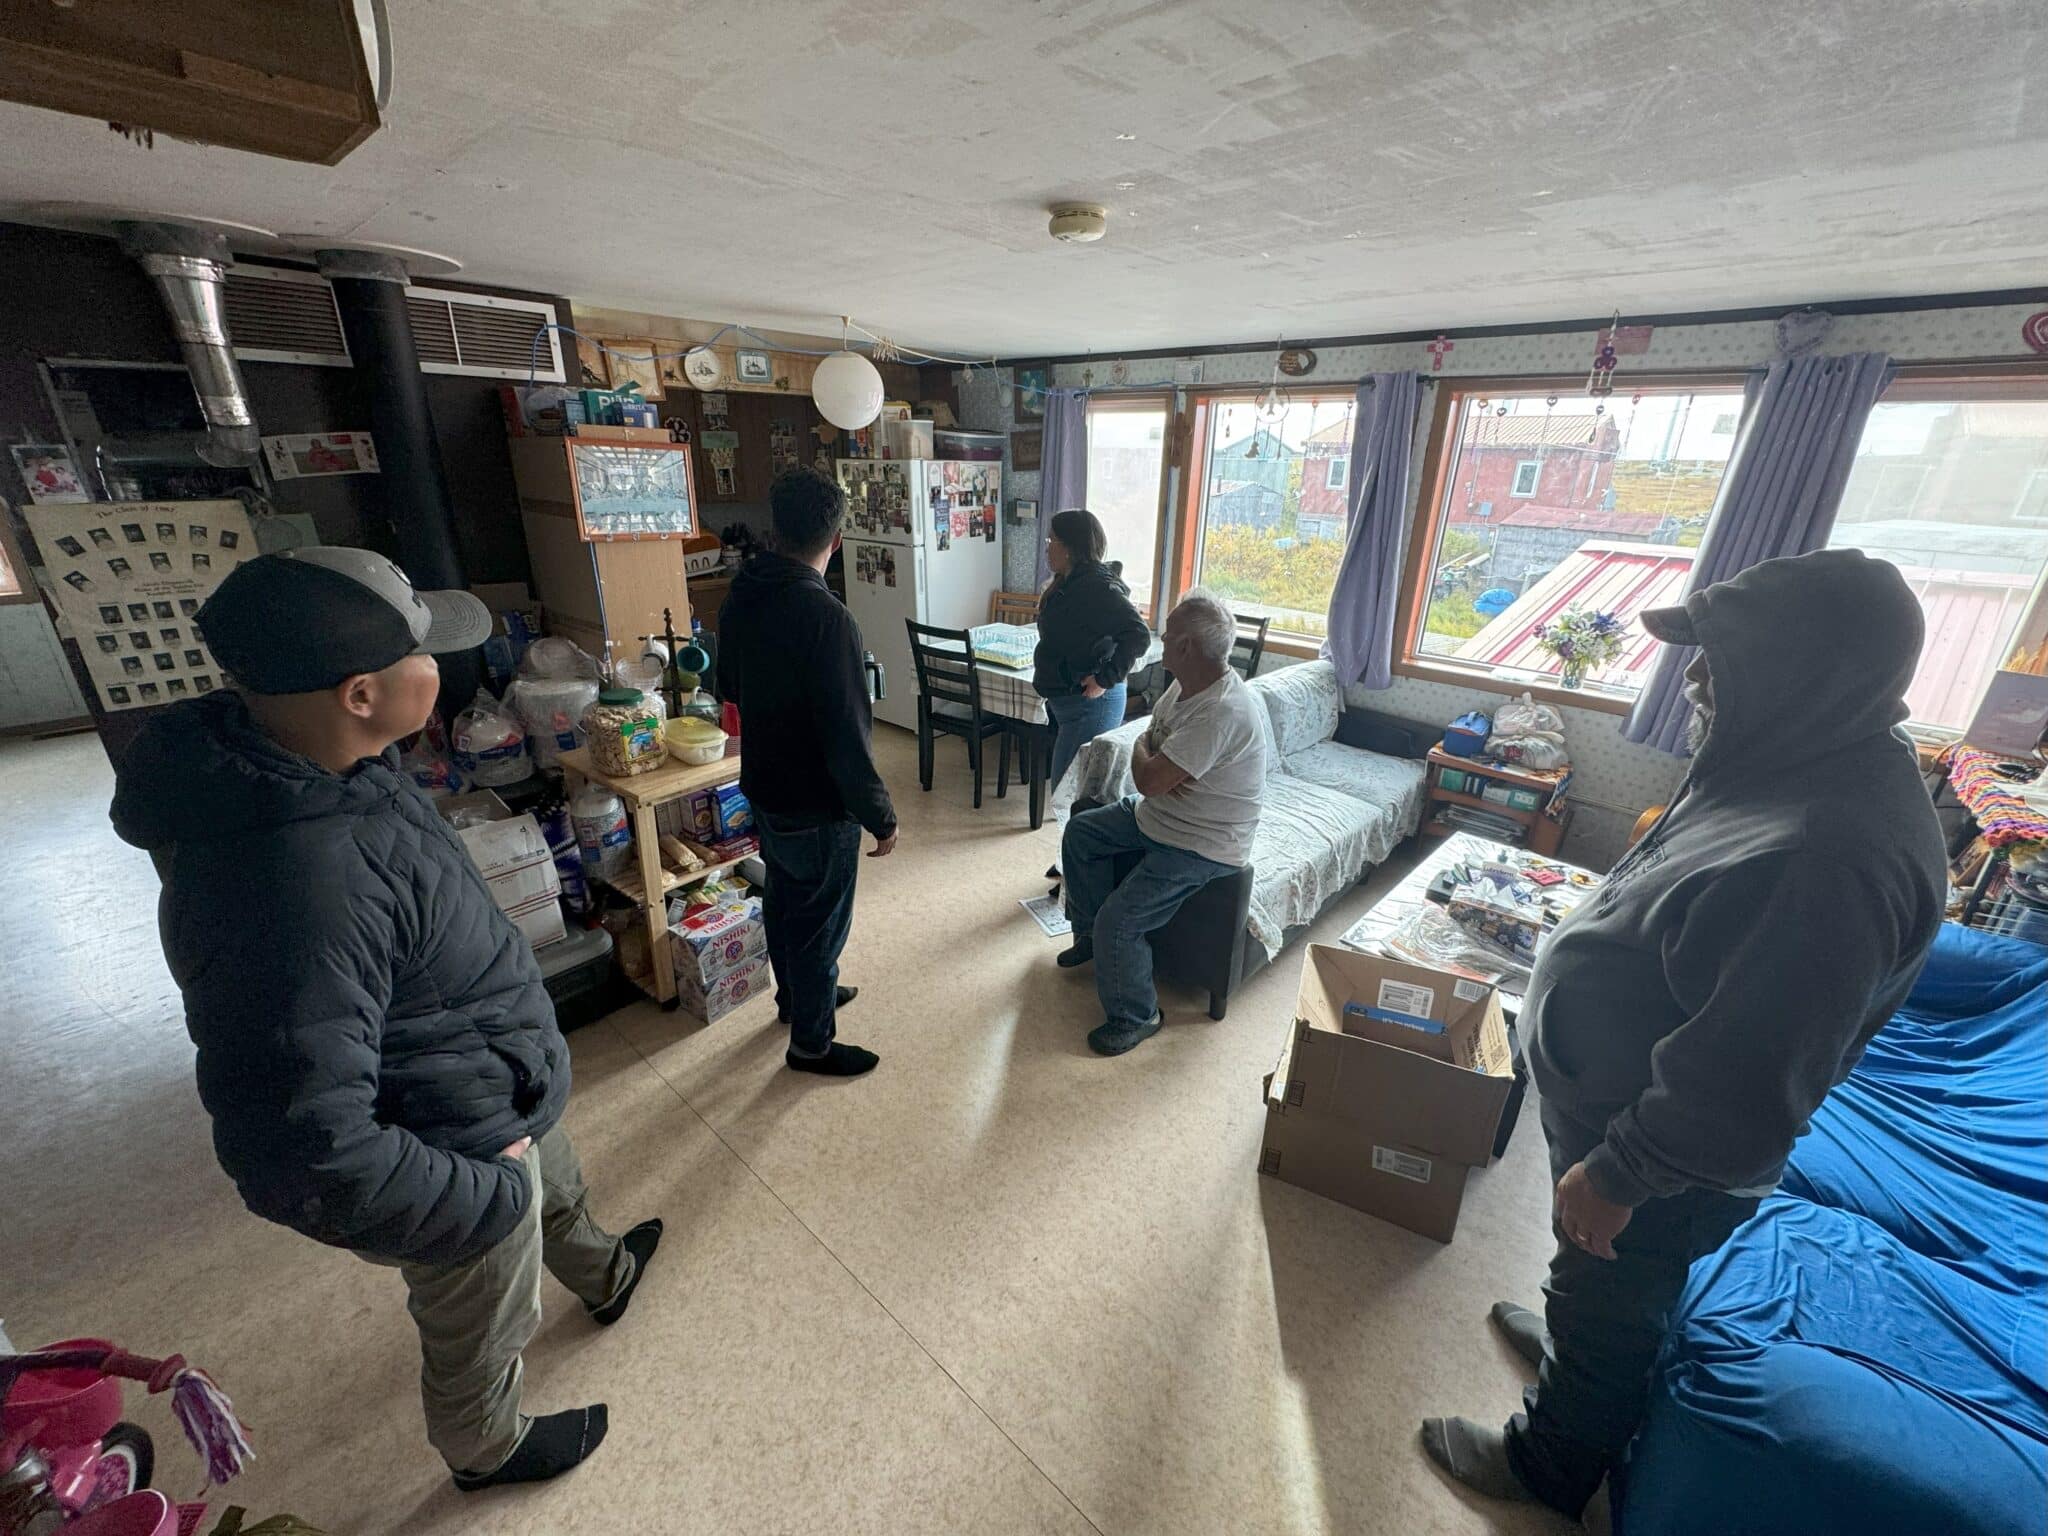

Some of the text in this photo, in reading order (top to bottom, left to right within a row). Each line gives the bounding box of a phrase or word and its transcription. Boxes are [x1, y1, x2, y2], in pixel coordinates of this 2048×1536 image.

[703, 913, 744, 933] NISHIKI
[712, 924, 751, 950] NISHIKI
[719, 963, 756, 990] NISHIKI
